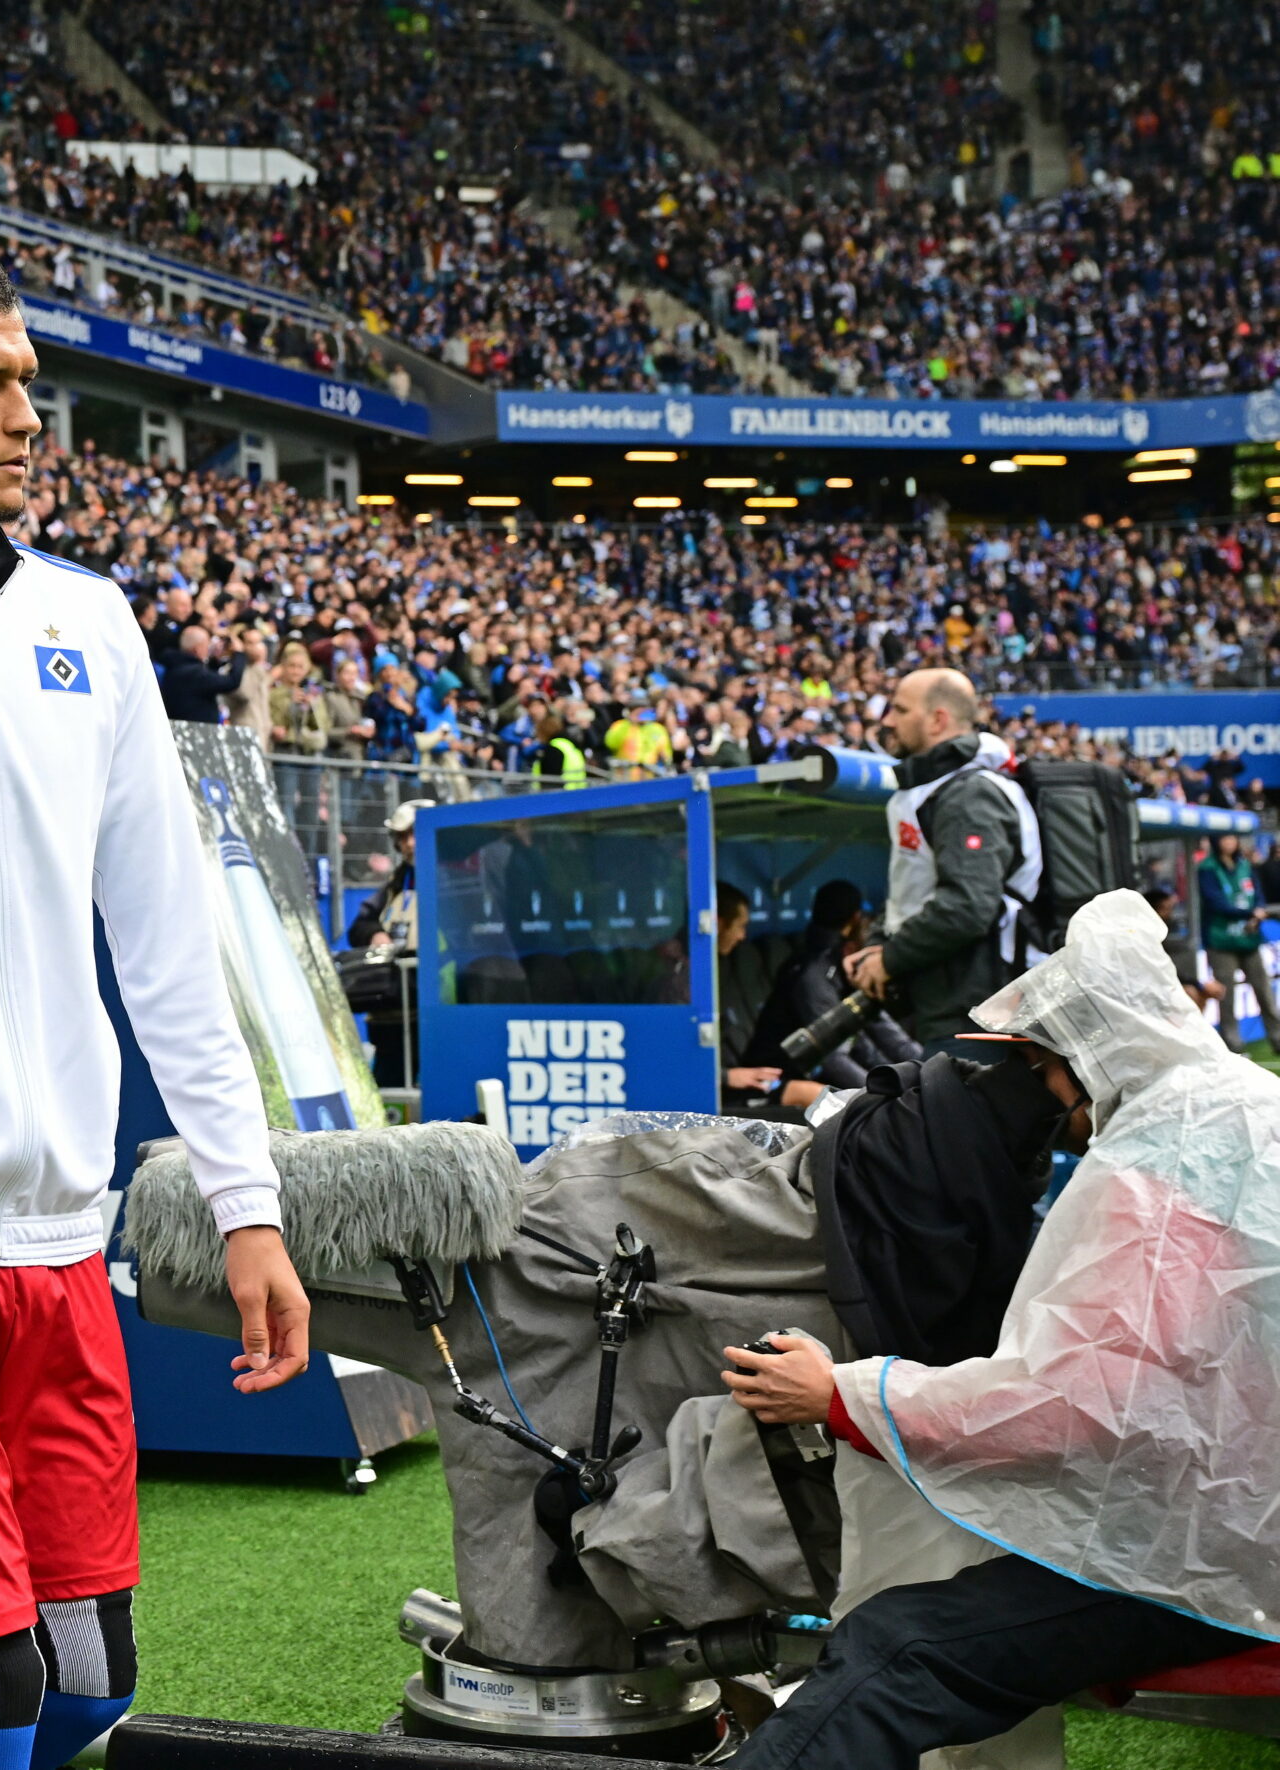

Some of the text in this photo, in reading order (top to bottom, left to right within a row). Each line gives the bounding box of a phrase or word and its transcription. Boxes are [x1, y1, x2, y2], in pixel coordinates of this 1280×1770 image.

[507, 404, 662, 430] HanseMerkur
[730, 406, 951, 439] FAMILIENBLOCK
[979, 412, 1118, 437] HanseMerkur
[506, 1019, 626, 1059] NUR
[507, 1060, 627, 1104] DER
[456, 1677, 514, 1697] TVN GROUP
